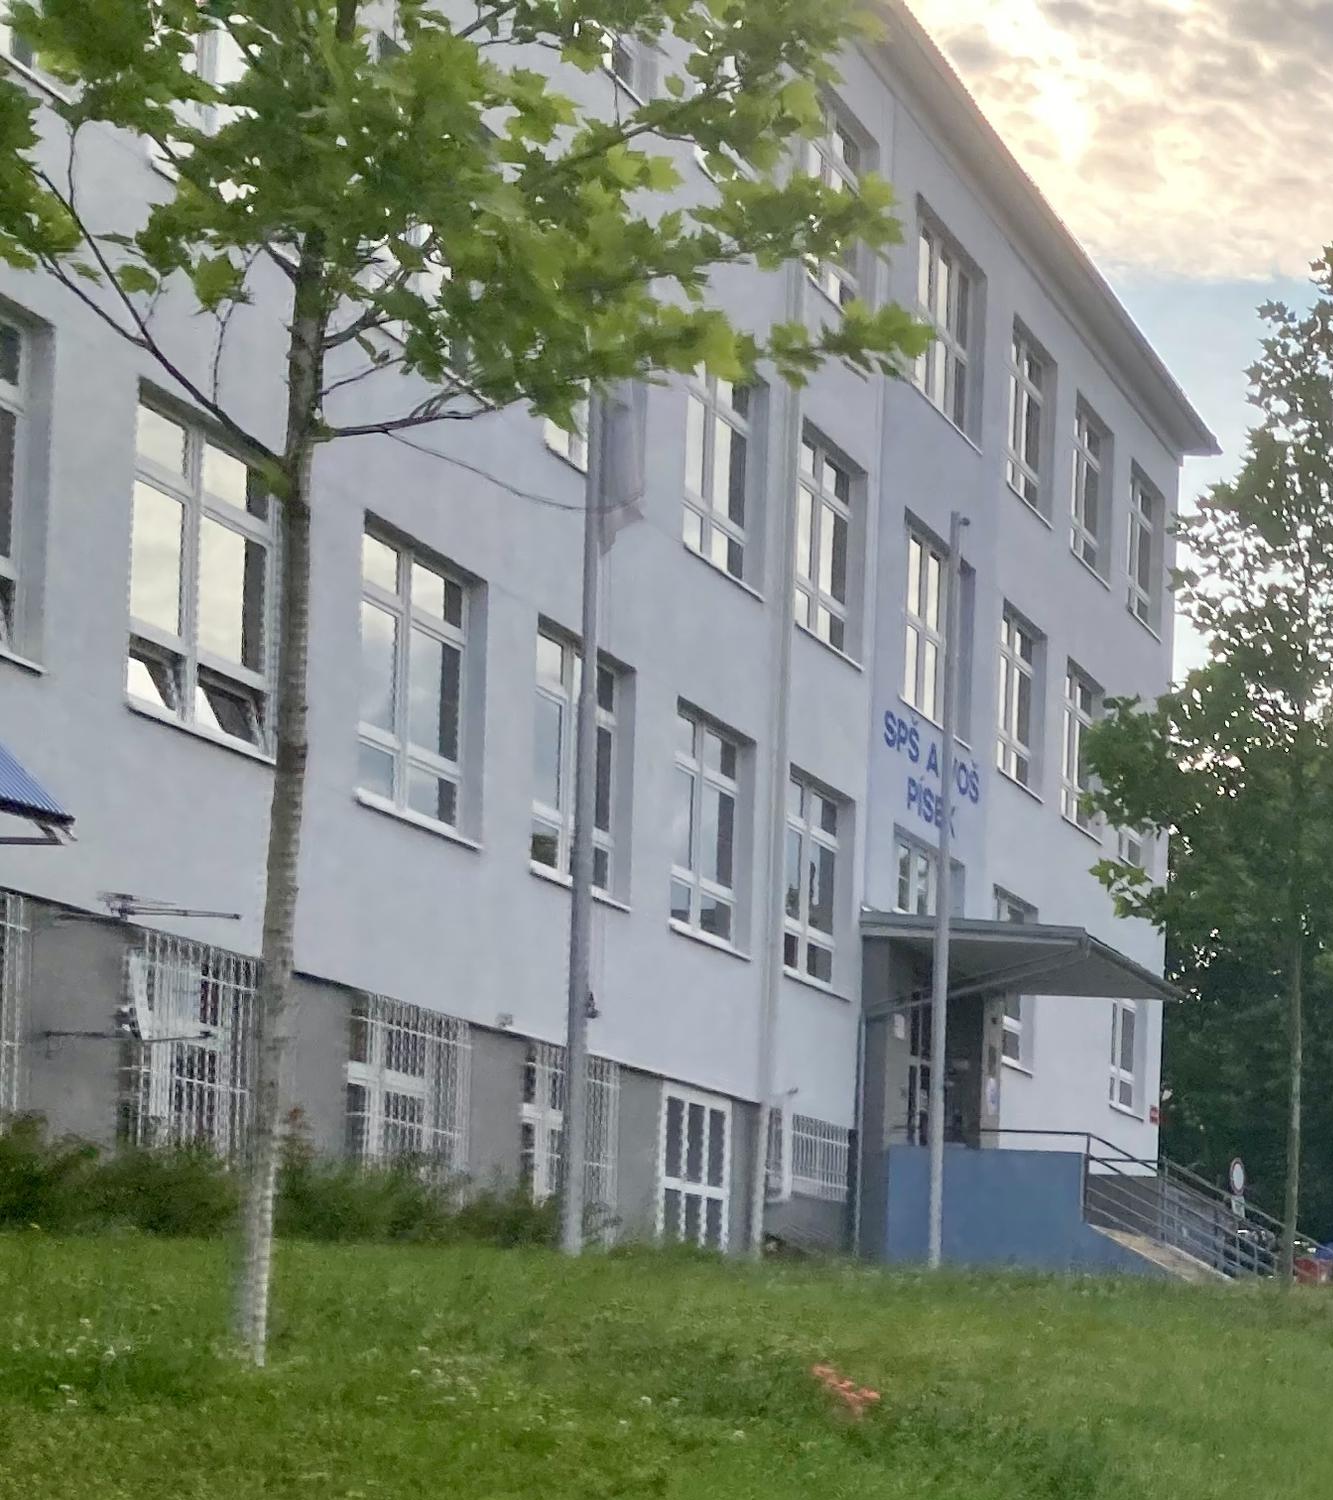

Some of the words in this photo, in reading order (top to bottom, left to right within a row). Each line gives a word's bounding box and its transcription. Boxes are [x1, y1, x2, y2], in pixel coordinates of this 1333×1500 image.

[884, 710, 920, 763] SPŠ
[926, 741, 939, 778] A
[951, 757, 980, 805] OŠ
